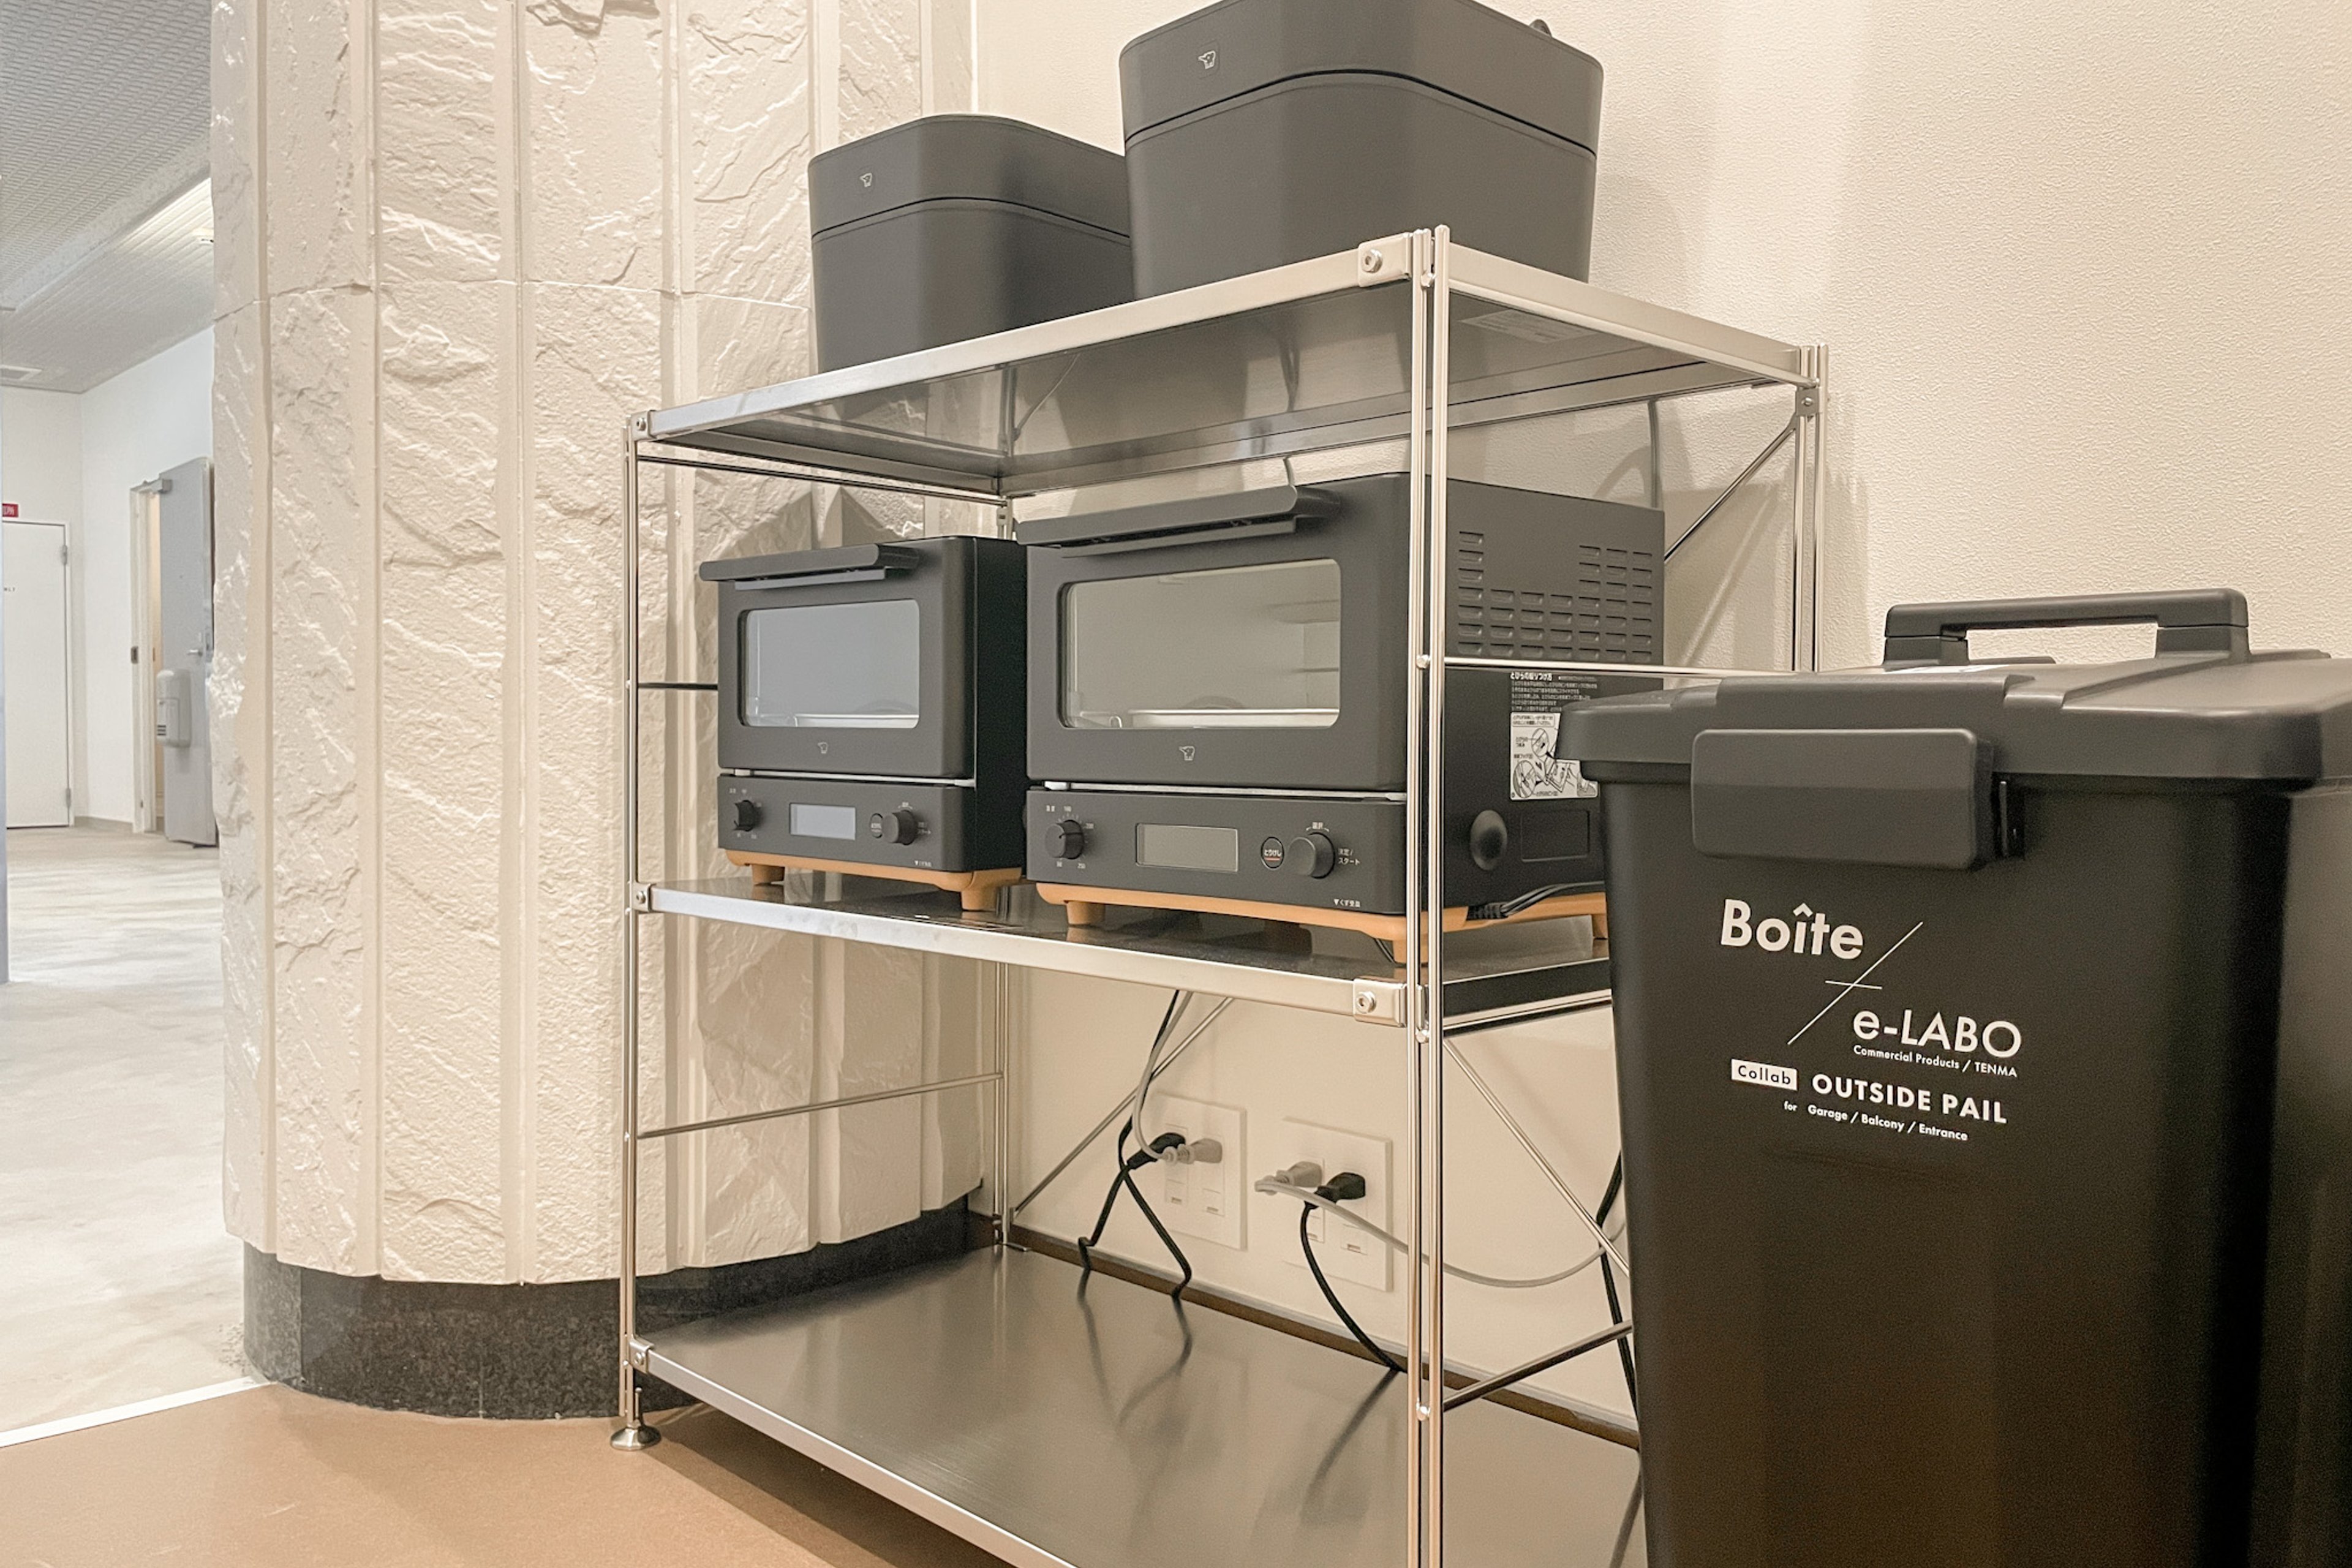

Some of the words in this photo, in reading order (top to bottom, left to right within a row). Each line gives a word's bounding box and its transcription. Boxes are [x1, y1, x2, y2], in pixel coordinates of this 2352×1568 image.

[1721, 899, 1864, 960] Boîte
[1853, 1009, 2022, 1058] e-LABO
[1738, 1065, 1791, 1085] Collab
[1853, 1044, 1913, 1063] Commercial
[1915, 1053, 1960, 1069] Products
[1962, 1060, 1971, 1072] /
[1974, 1061, 2018, 1078] TENMA
[1784, 1101, 1798, 1112] for
[1807, 1104, 1848, 1121] Garage
[1850, 1111, 1859, 1124] /
[1861, 1114, 1905, 1133] Balcony
[1907, 1121, 1917, 1134] /
[1918, 1123, 1969, 1141] Entrance
[1812, 1074, 1931, 1111] OUTSIDE
[1942, 1093, 2007, 1125] PAIL
